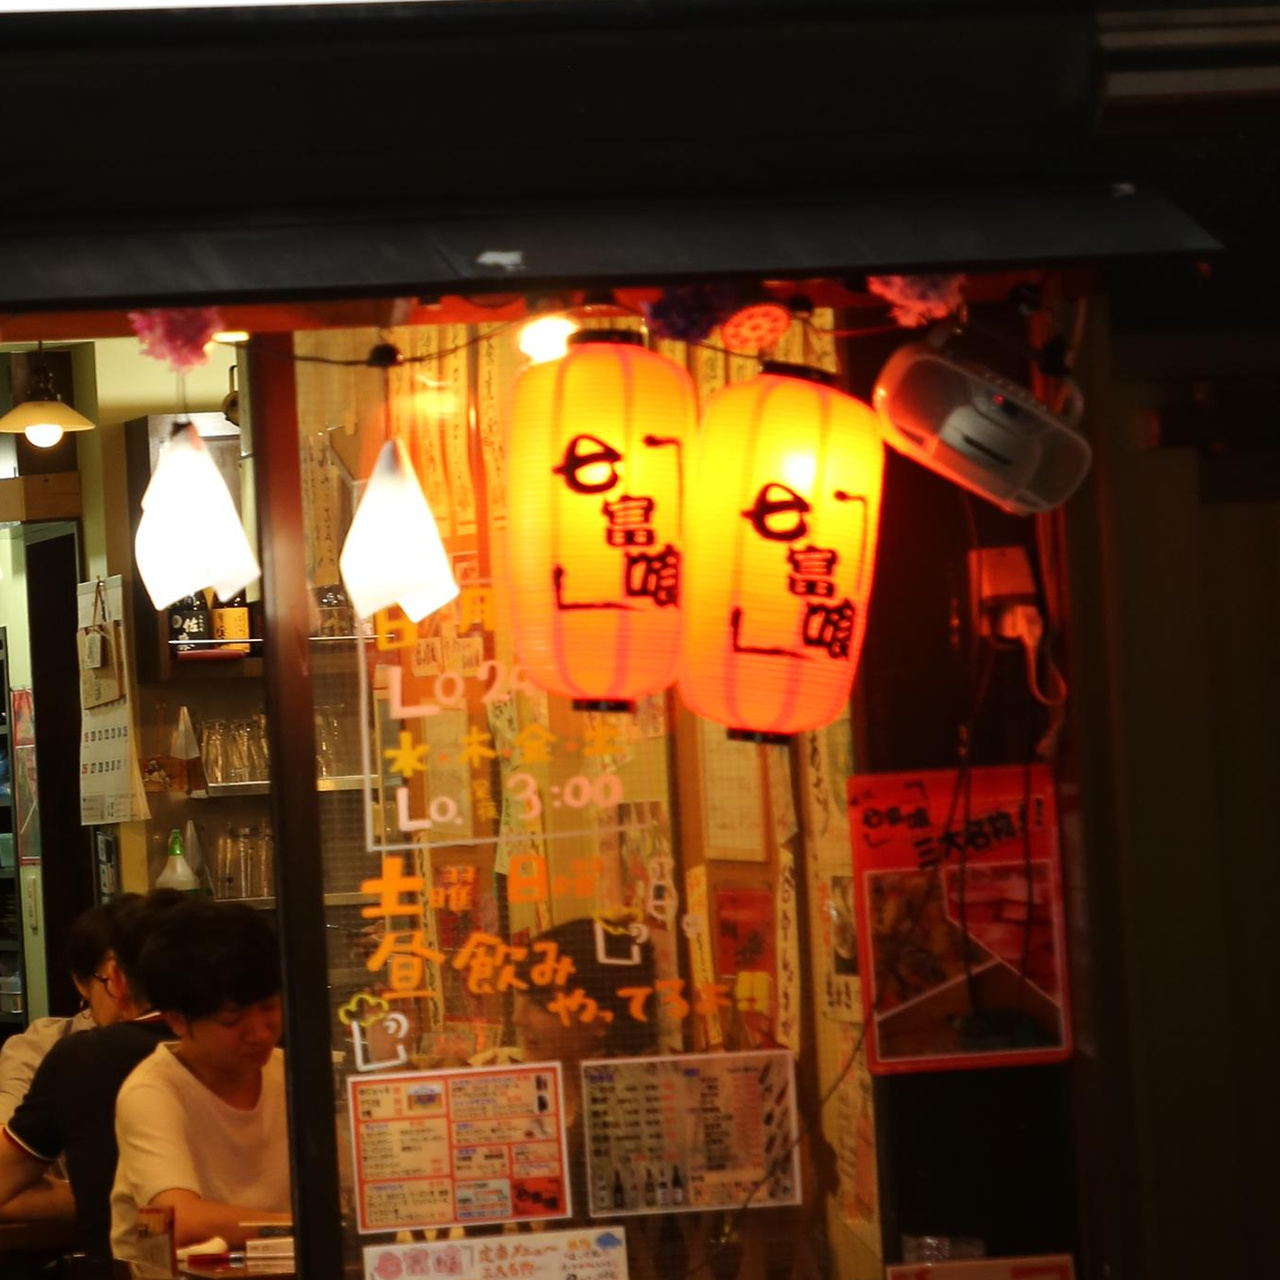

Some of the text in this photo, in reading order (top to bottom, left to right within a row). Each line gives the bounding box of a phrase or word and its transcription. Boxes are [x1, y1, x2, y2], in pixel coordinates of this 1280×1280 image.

[507, 772, 624, 821] 3:00
[360, 852, 604, 919] 土曜 日曜
[366, 928, 577, 1002] 昼飲み
